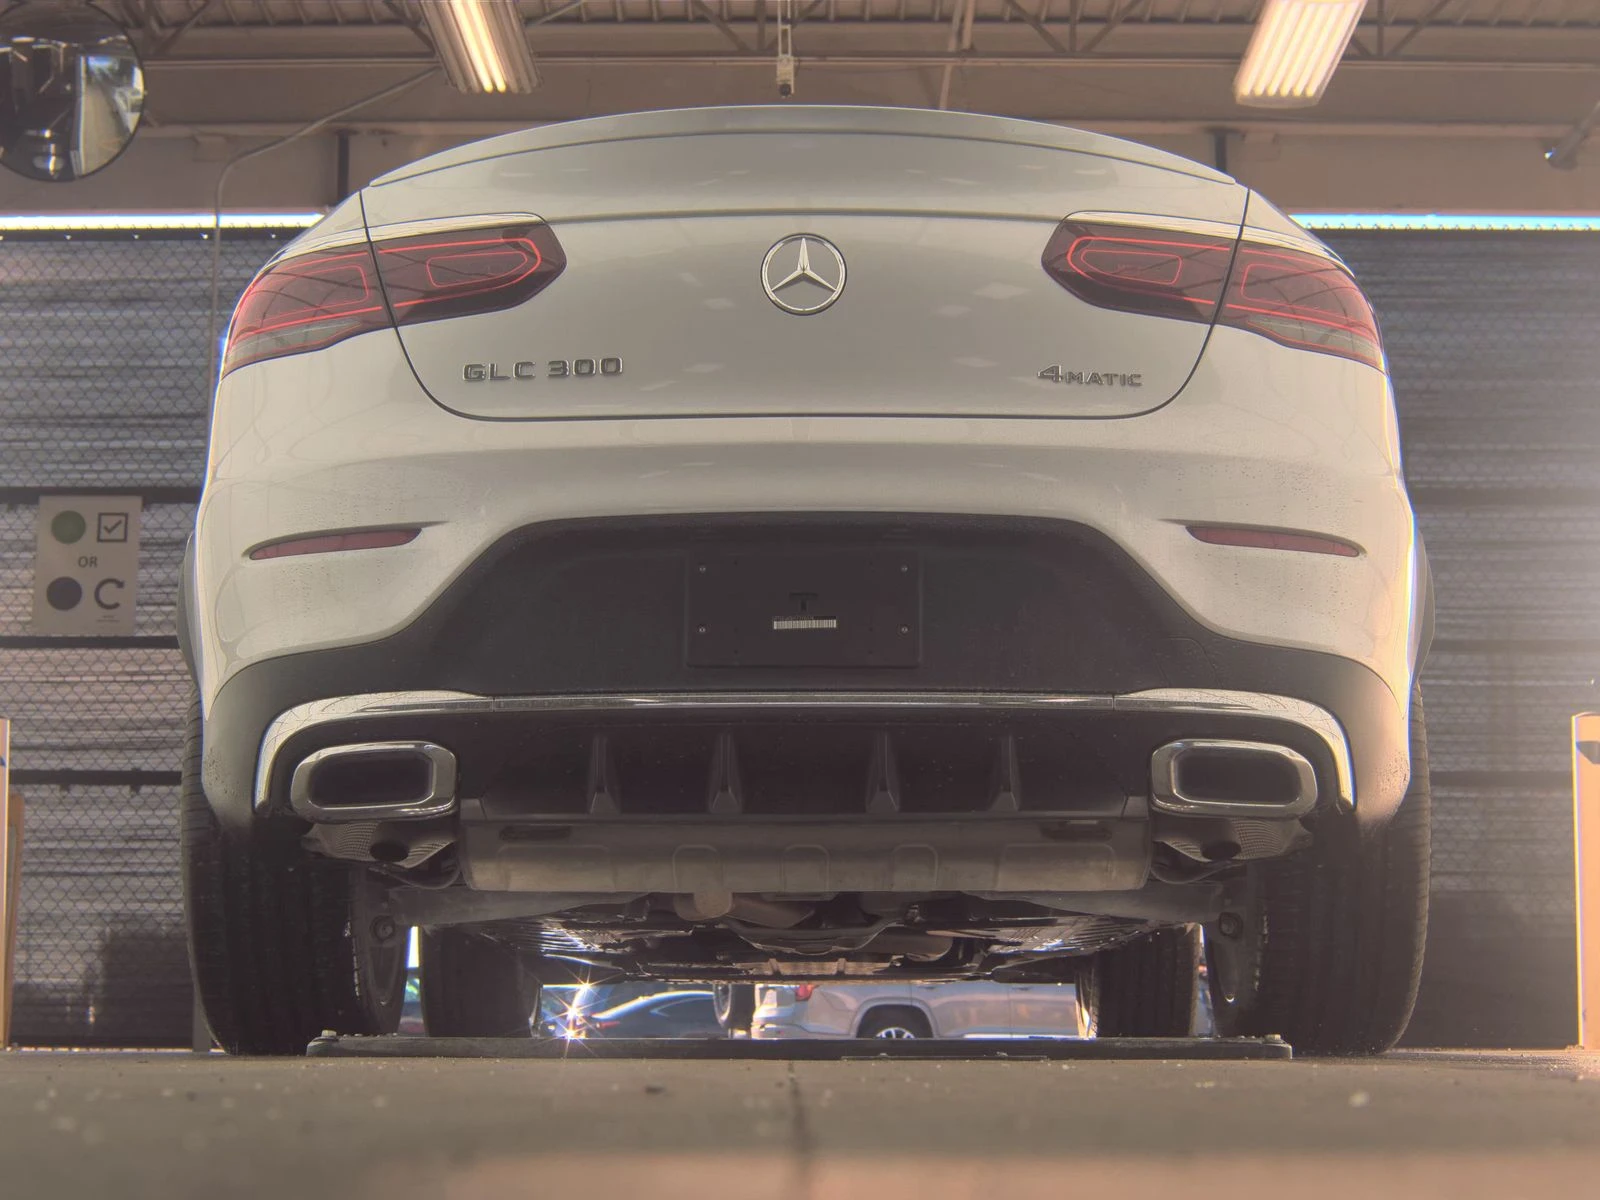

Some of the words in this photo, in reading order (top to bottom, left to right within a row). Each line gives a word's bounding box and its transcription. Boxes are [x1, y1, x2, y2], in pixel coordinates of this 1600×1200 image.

[463, 361, 536, 381] GLC
[546, 357, 623, 377] 300
[1037, 364, 1143, 387] 4MATIC
[78, 556, 98, 568] OR
